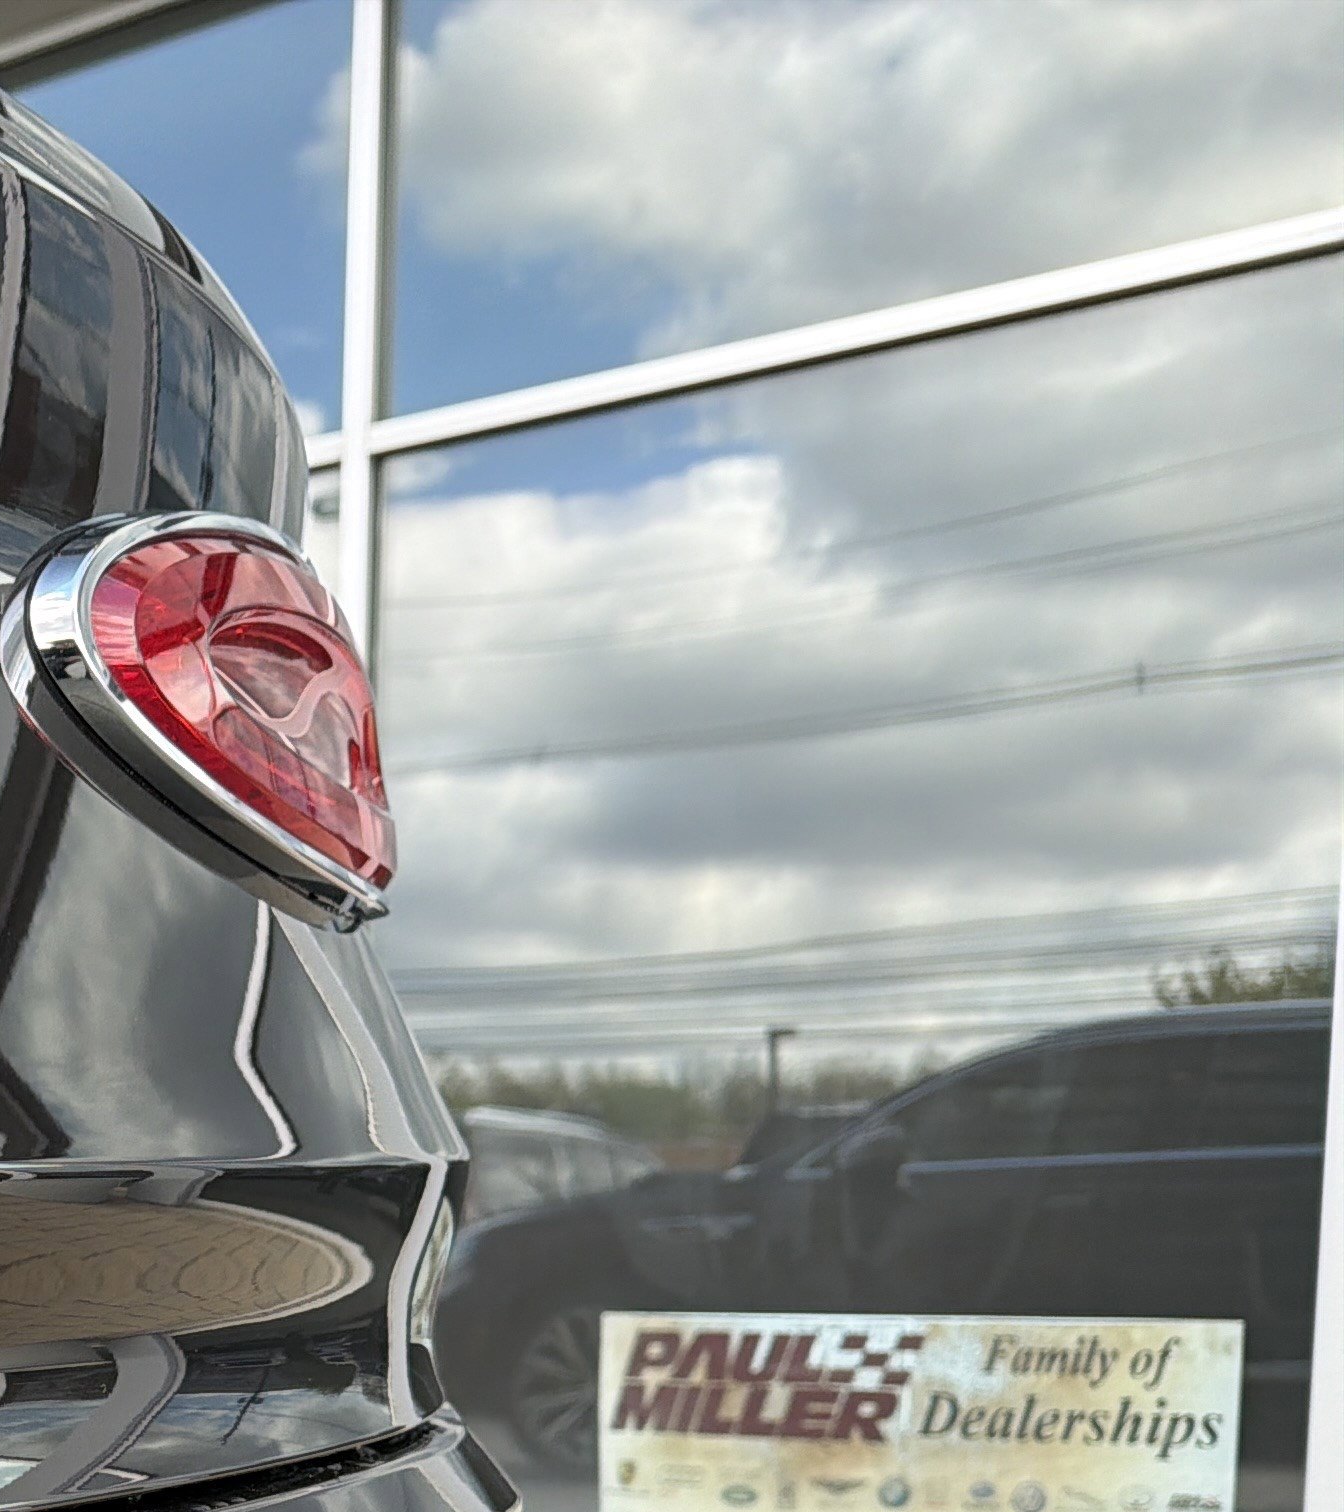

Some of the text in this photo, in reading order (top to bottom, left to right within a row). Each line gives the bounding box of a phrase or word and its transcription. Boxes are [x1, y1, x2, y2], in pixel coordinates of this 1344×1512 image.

[625, 1330, 824, 1382] PAUL
[983, 1334, 1180, 1391] Family of
[613, 1384, 898, 1441] MILLER
[917, 1391, 1223, 1458] Dealerships
